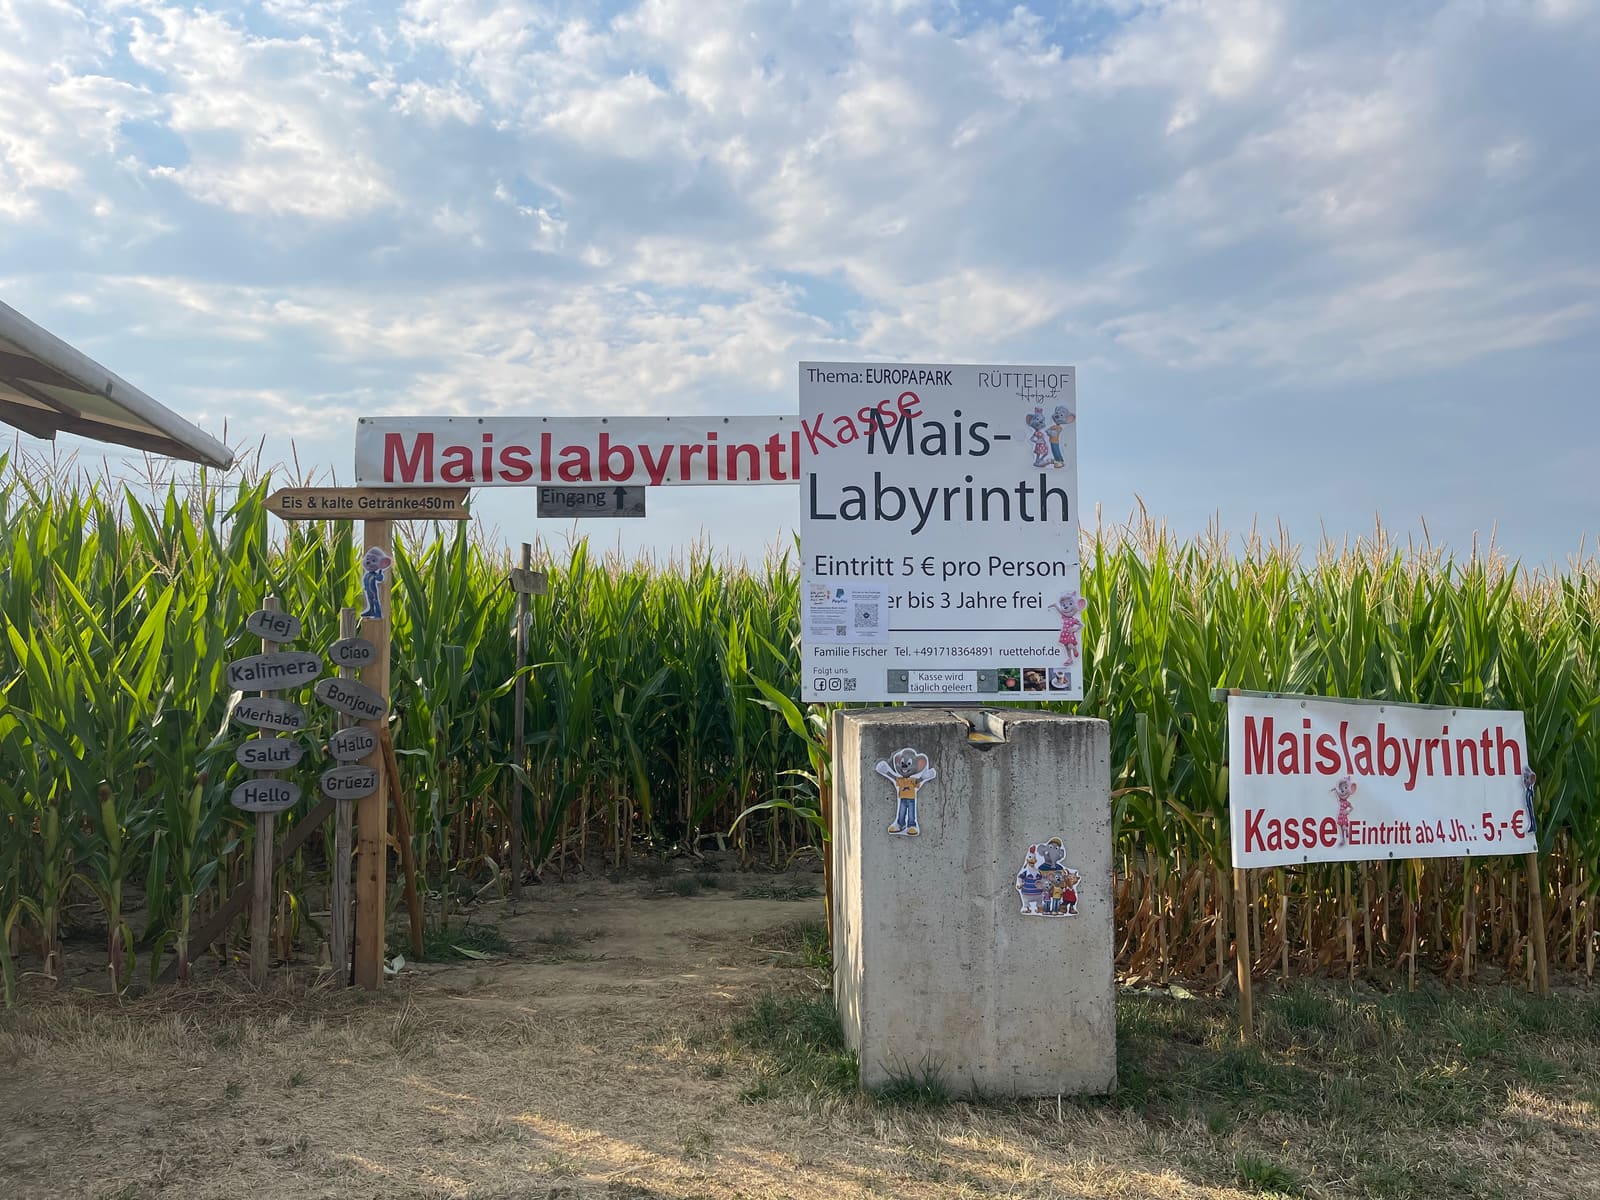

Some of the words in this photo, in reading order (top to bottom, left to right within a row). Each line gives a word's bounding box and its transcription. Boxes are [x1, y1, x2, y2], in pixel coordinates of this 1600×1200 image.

[807, 368, 863, 383] Thema:
[866, 368, 953, 386] EUROPAPARK
[978, 370, 1070, 389] RÜTTEHOF
[801, 391, 924, 456] Kasse
[867, 408, 1012, 457] Mais-
[281, 496, 303, 509] Eis
[307, 496, 317, 509] &
[321, 496, 354, 509] kalte
[541, 488, 606, 507] Eingang
[809, 471, 1069, 536] Labyrinth
[815, 555, 894, 576] Eintritt
[901, 557, 914, 576] 5
[921, 557, 936, 576] €
[942, 560, 981, 581] pro
[989, 556, 1066, 577] Person
[908, 591, 935, 609] bis
[940, 592, 951, 609] 3
[956, 591, 1007, 609] Jahre
[1012, 591, 1043, 609] frei
[259, 612, 292, 637] Hej
[339, 645, 370, 660] Ciao
[814, 646, 850, 657] Familie
[852, 646, 888, 657] Fischer
[893, 646, 911, 657] Tel.
[999, 646, 1061, 657] ruettehof.de
[231, 660, 318, 682] Kalimera
[812, 667, 833, 676] Folgt
[918, 672, 943, 681] Kasse
[944, 672, 964, 681] wird
[910, 682, 940, 693] täglich
[941, 682, 973, 693] geleert
[326, 683, 383, 717] Bonjour
[235, 705, 300, 727] Merhaba
[337, 735, 373, 754] Hallo
[1244, 715, 1522, 792] Maislabyrinth
[244, 747, 291, 763] Salut
[326, 772, 375, 790] Grüezi
[244, 787, 291, 803] Hello
[1244, 808, 1339, 853] Kasse
[1349, 820, 1412, 845] Eintritt
